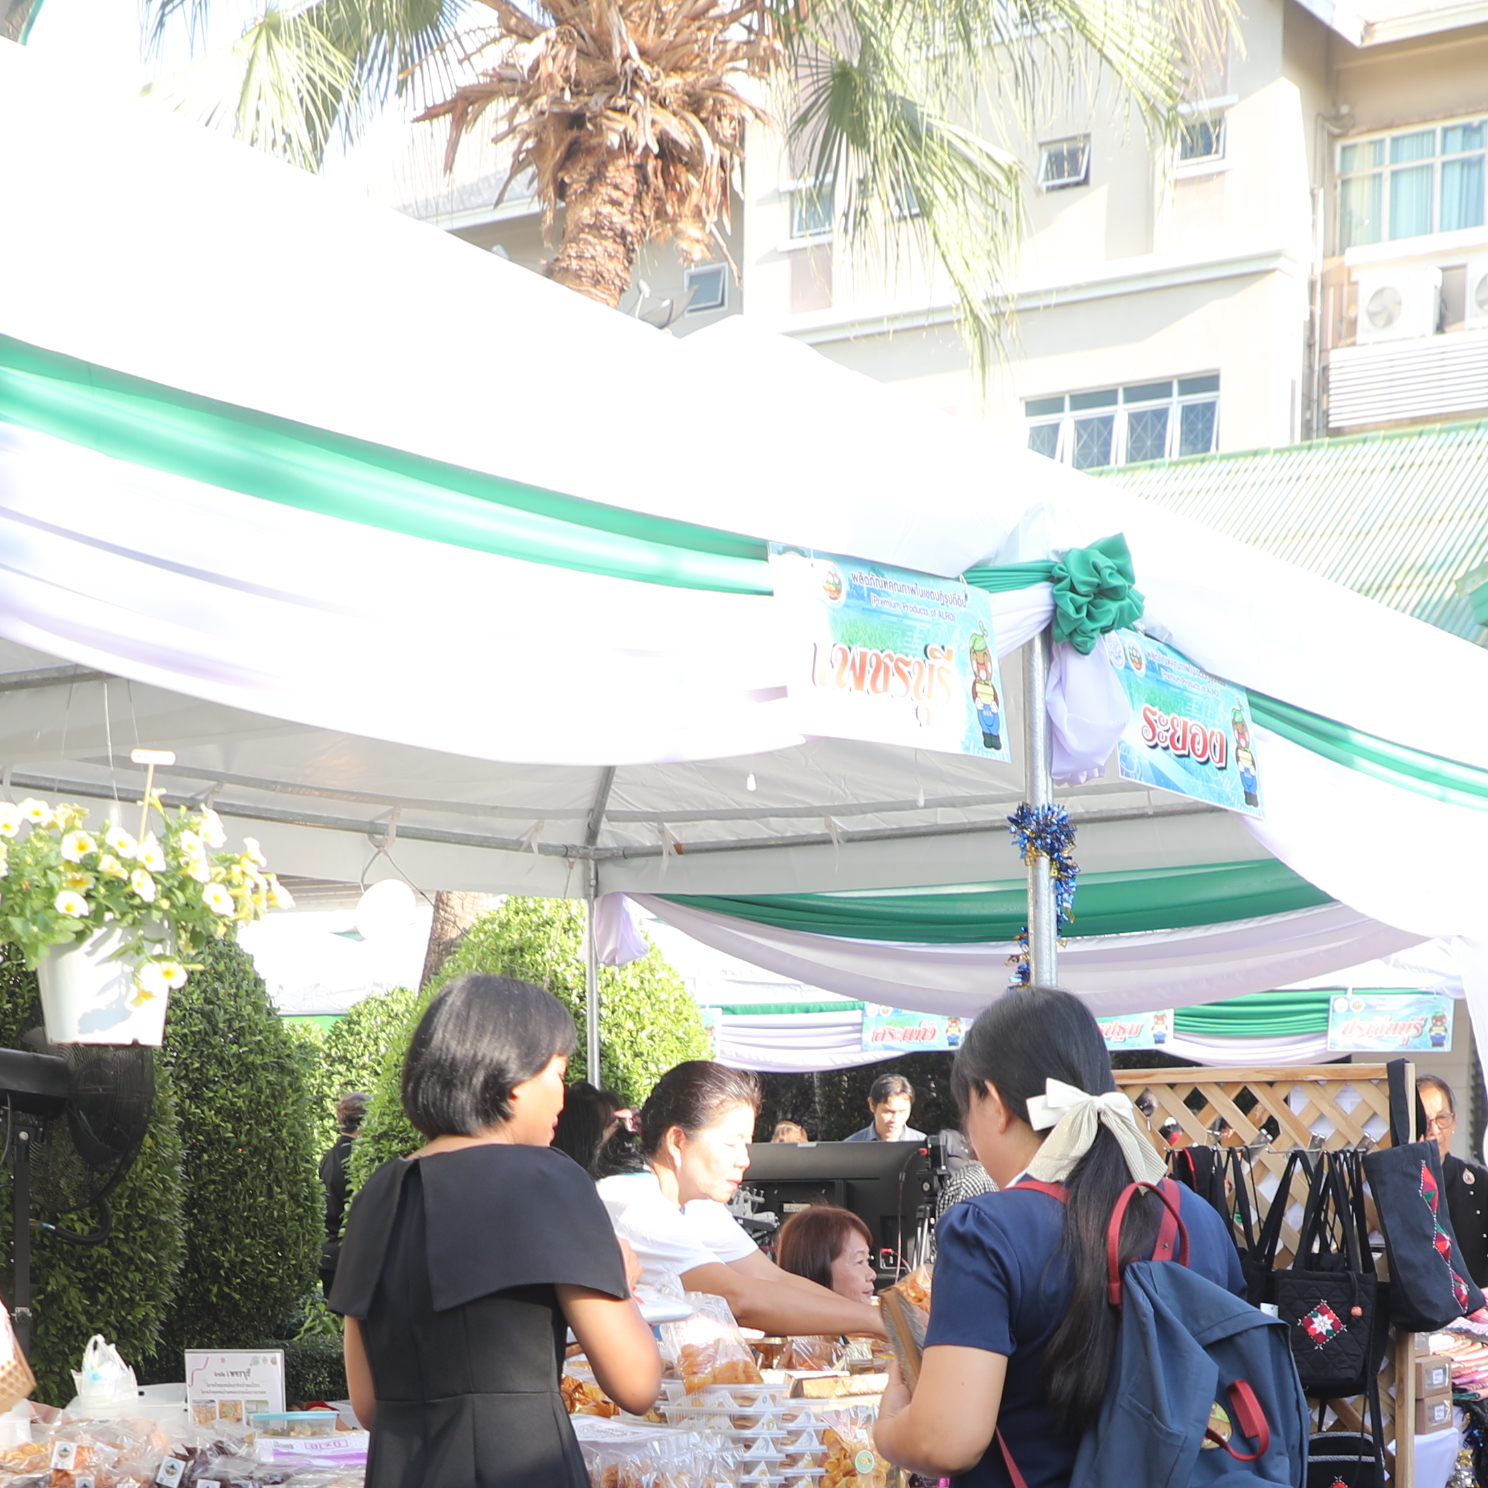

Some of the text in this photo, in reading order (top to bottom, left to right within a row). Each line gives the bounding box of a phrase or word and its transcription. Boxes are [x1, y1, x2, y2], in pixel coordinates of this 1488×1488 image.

[1141, 706, 1226, 765] ระยอง
[873, 1020, 937, 1043] สระแก้ว
